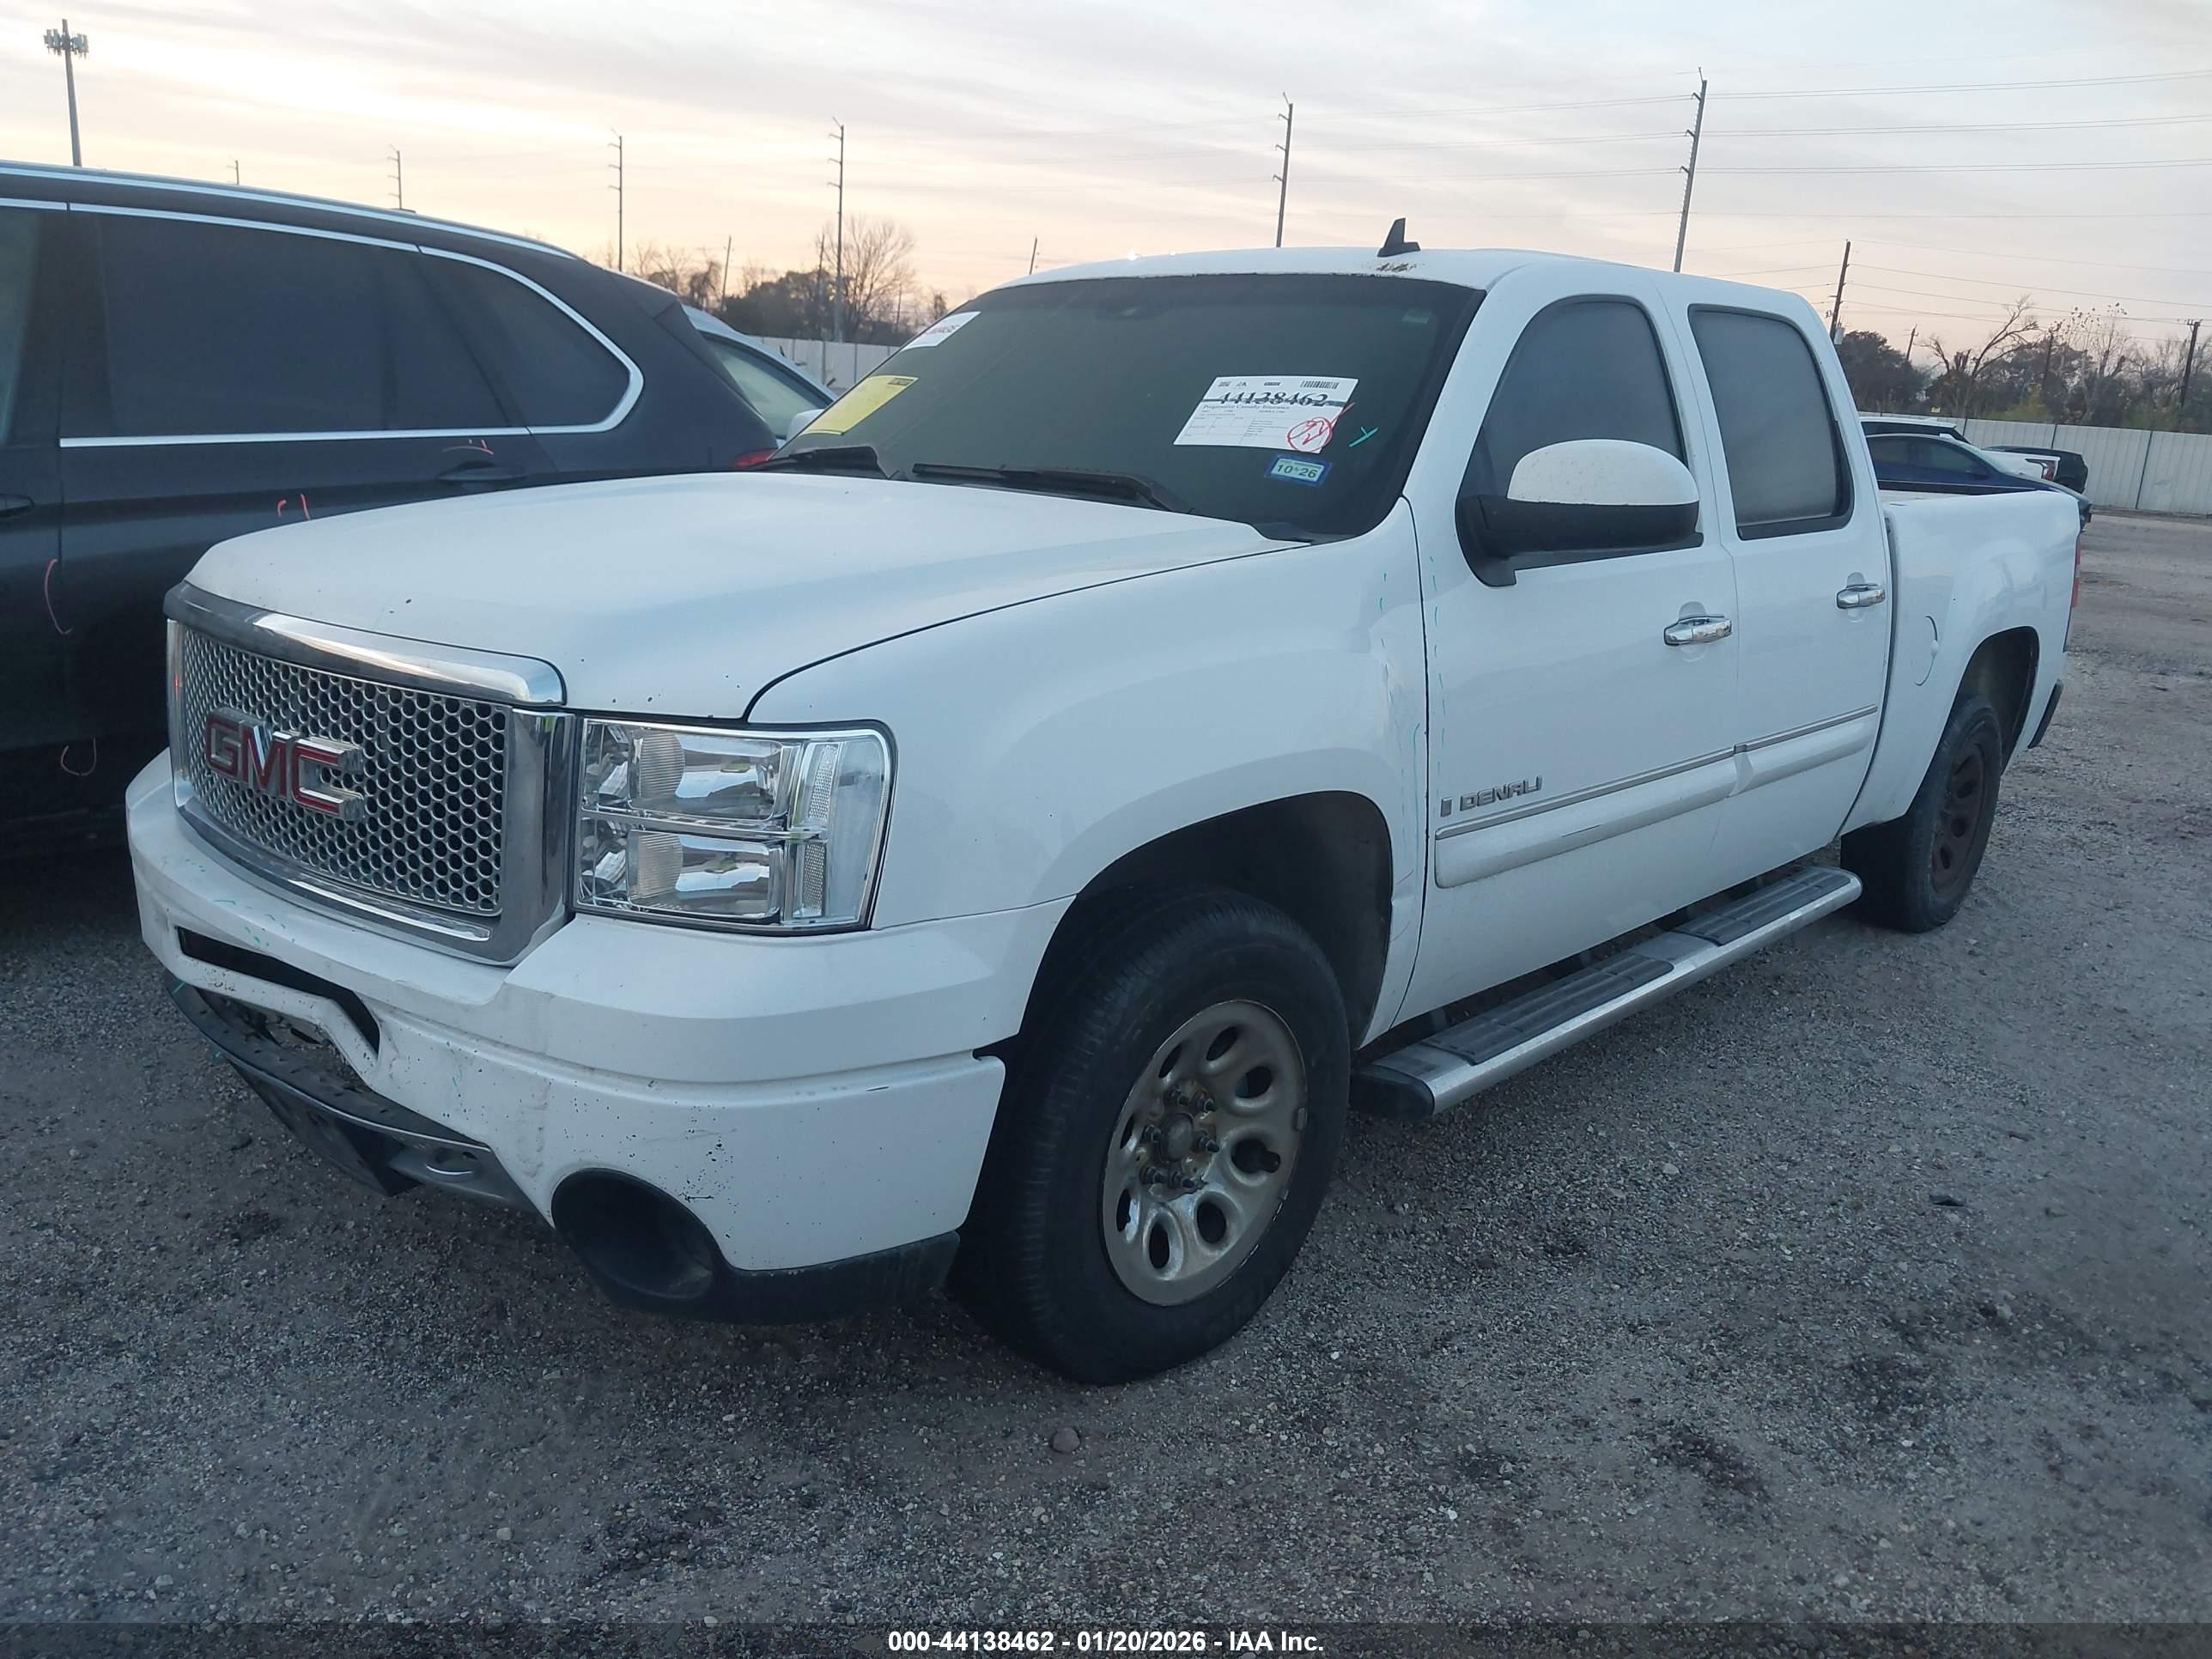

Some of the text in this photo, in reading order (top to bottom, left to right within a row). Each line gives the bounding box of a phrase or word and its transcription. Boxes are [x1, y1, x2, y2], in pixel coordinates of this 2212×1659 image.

[1219, 392, 1328, 407] 44138462
[205, 708, 364, 822] GMC
[1460, 775, 1542, 811] DENALI
